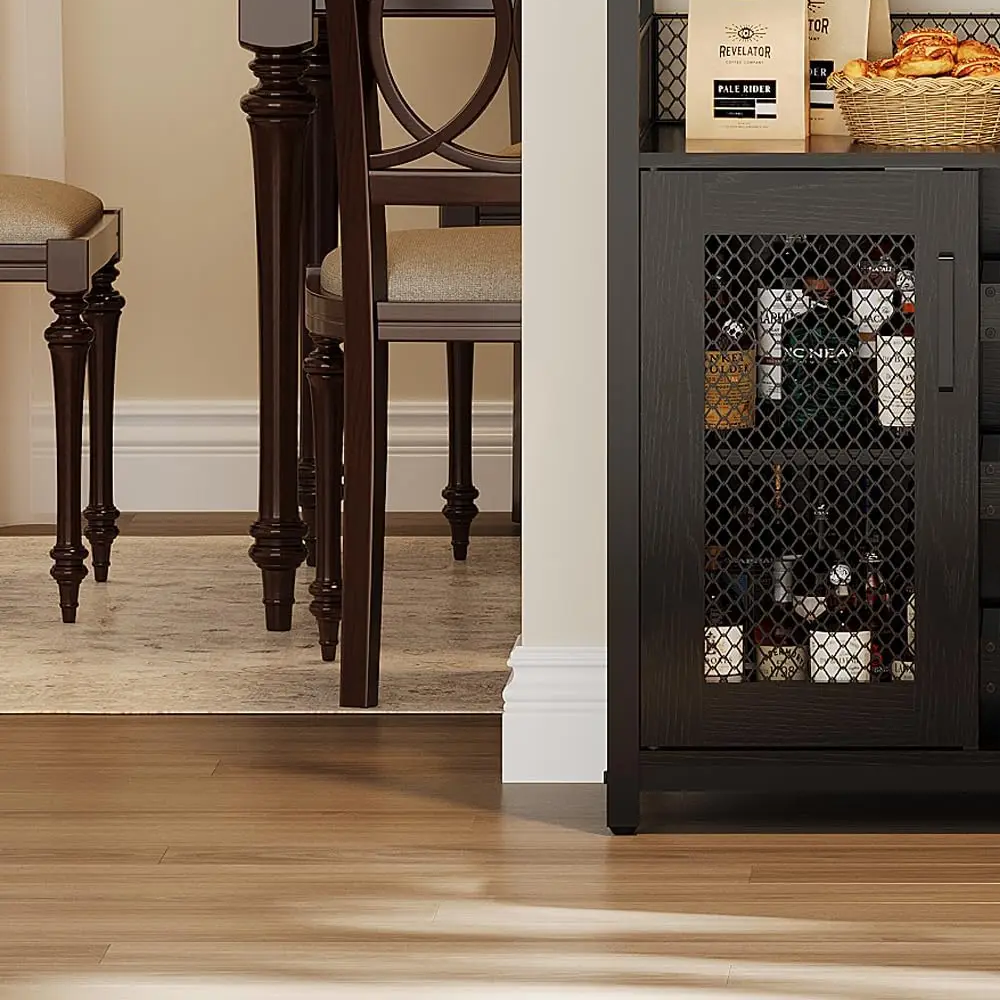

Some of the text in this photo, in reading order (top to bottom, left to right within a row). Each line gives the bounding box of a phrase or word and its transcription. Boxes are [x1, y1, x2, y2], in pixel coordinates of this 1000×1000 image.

[719, 45, 771, 59] REVELATOR
[718, 84, 771, 93] PALE RIDER
